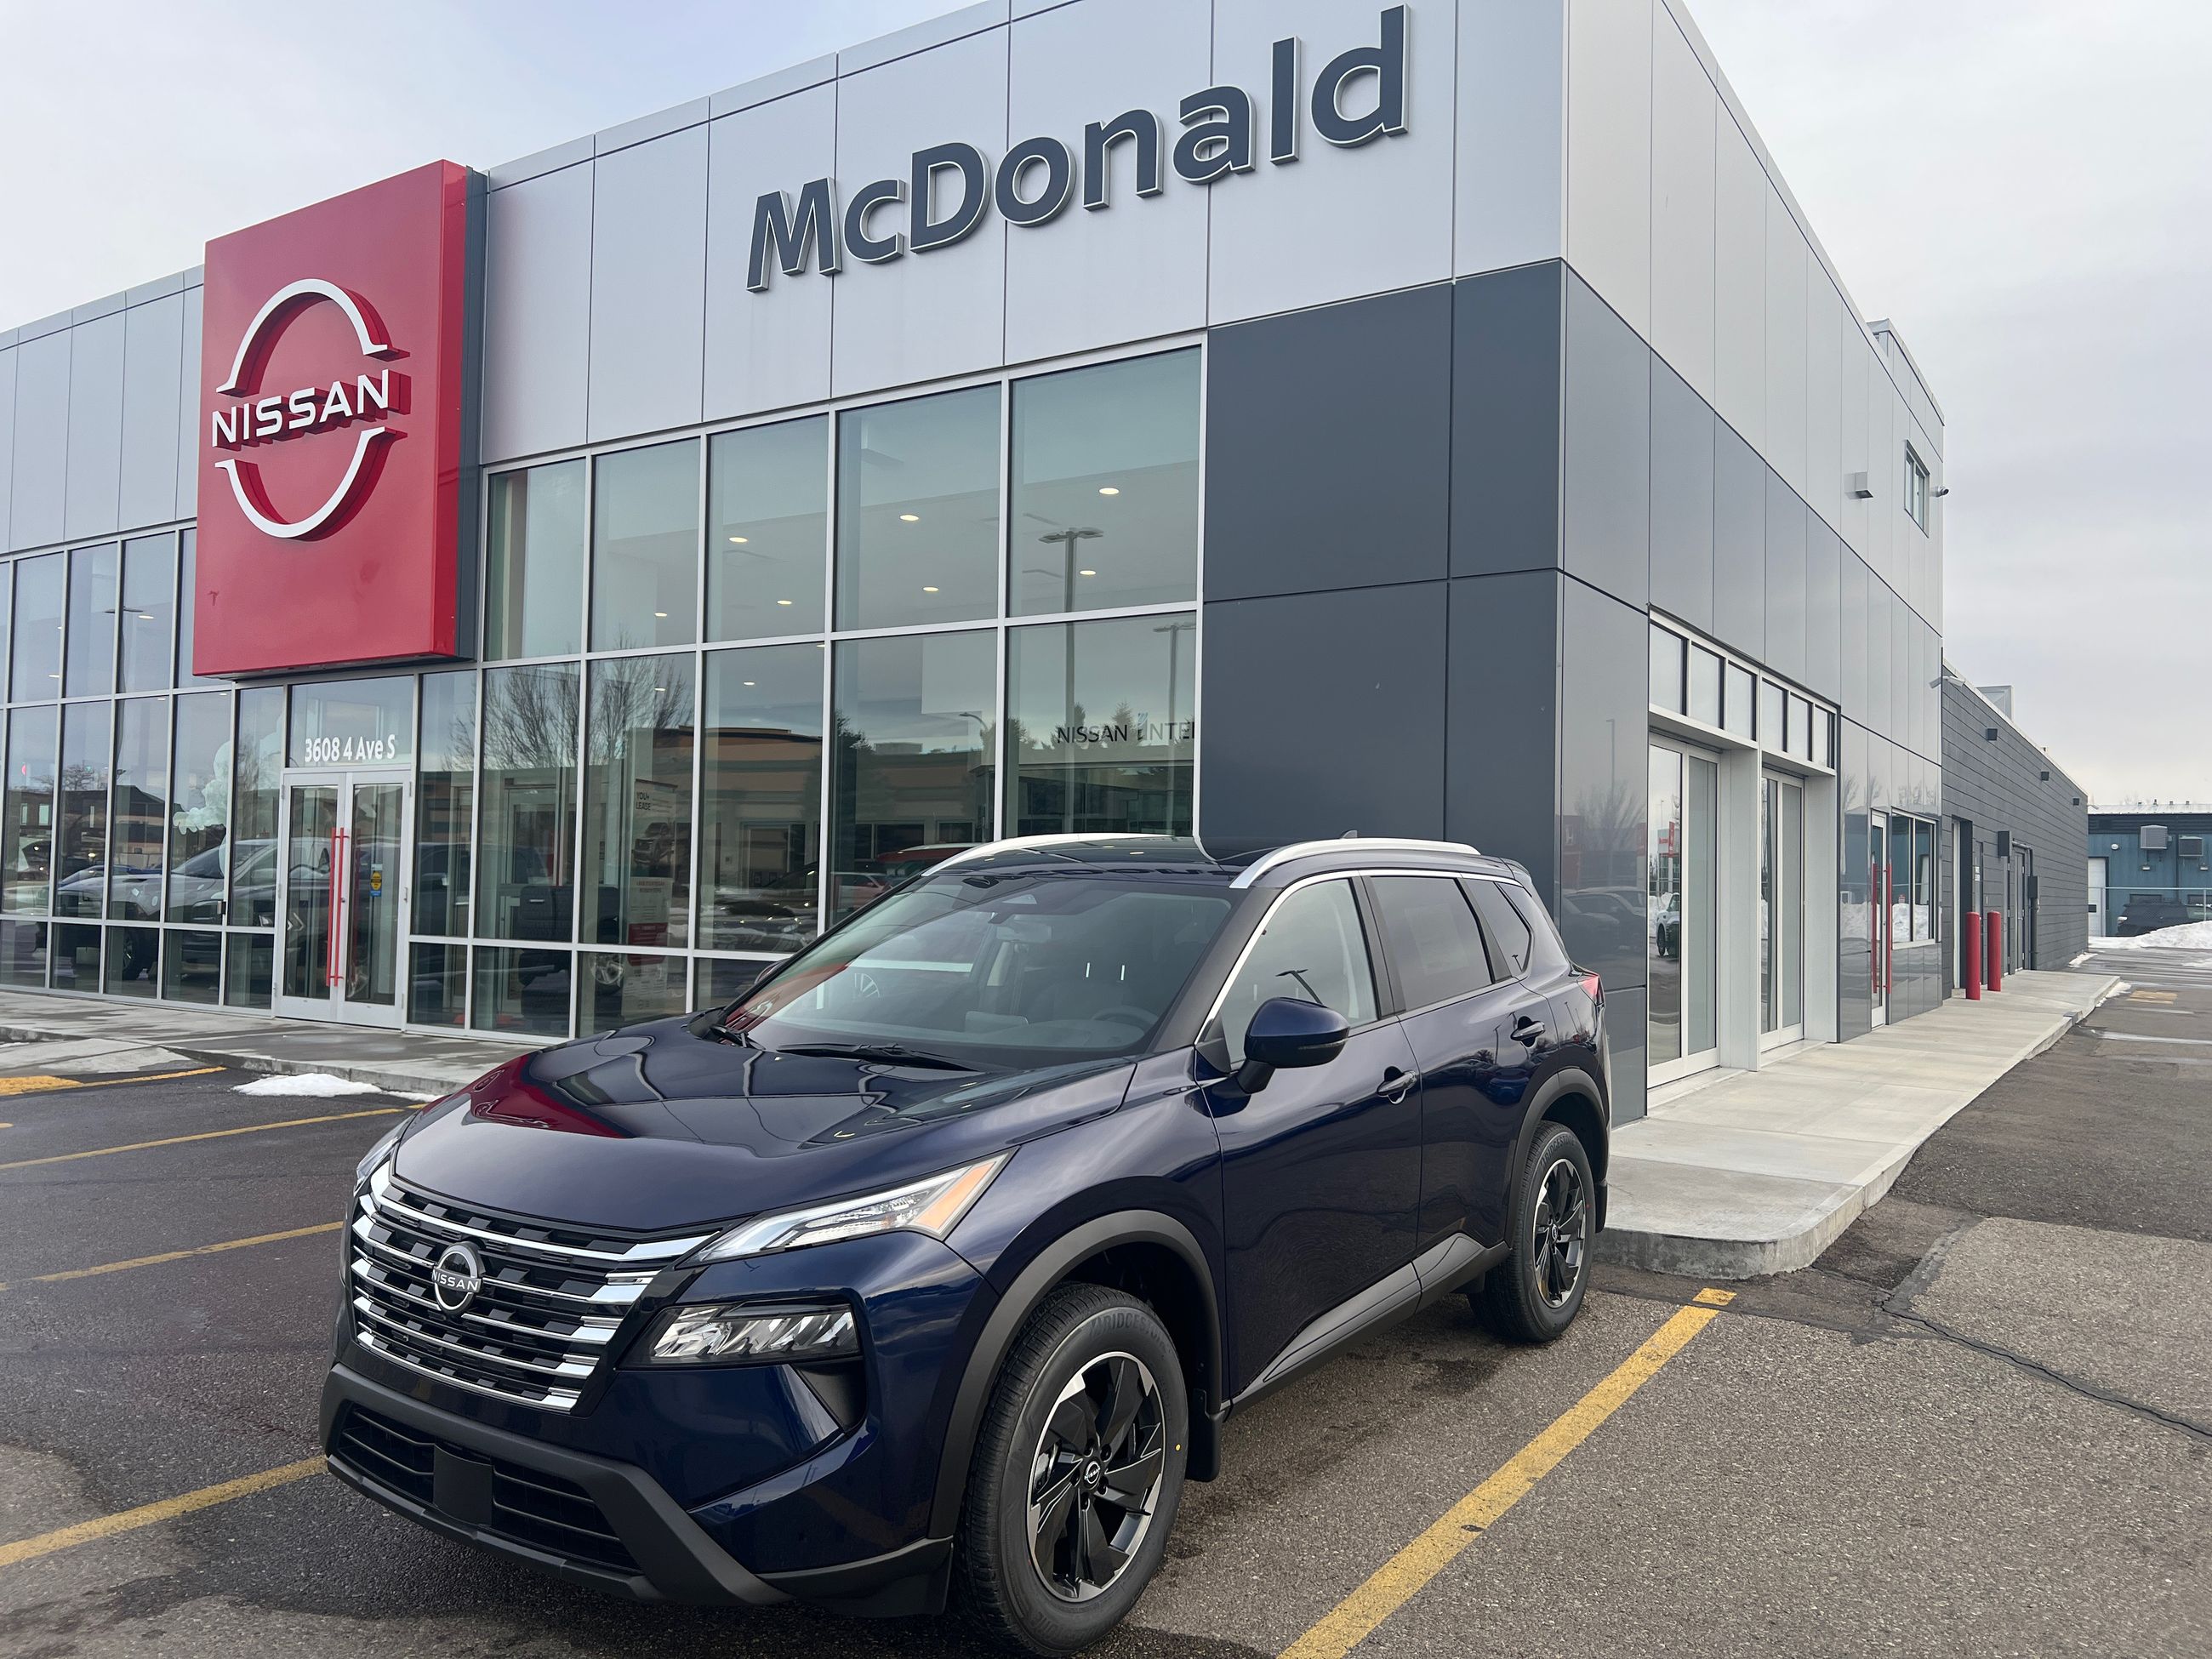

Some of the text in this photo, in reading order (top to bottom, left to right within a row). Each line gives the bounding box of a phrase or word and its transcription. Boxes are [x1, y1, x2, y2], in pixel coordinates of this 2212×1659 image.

[745, 3, 1411, 293] McDonald
[211, 368, 390, 448] NISSAN
[305, 733, 396, 762] 3608 4 Ave S
[1058, 724, 1127, 744] NISSAN
[431, 1268, 478, 1291] NISSAN
